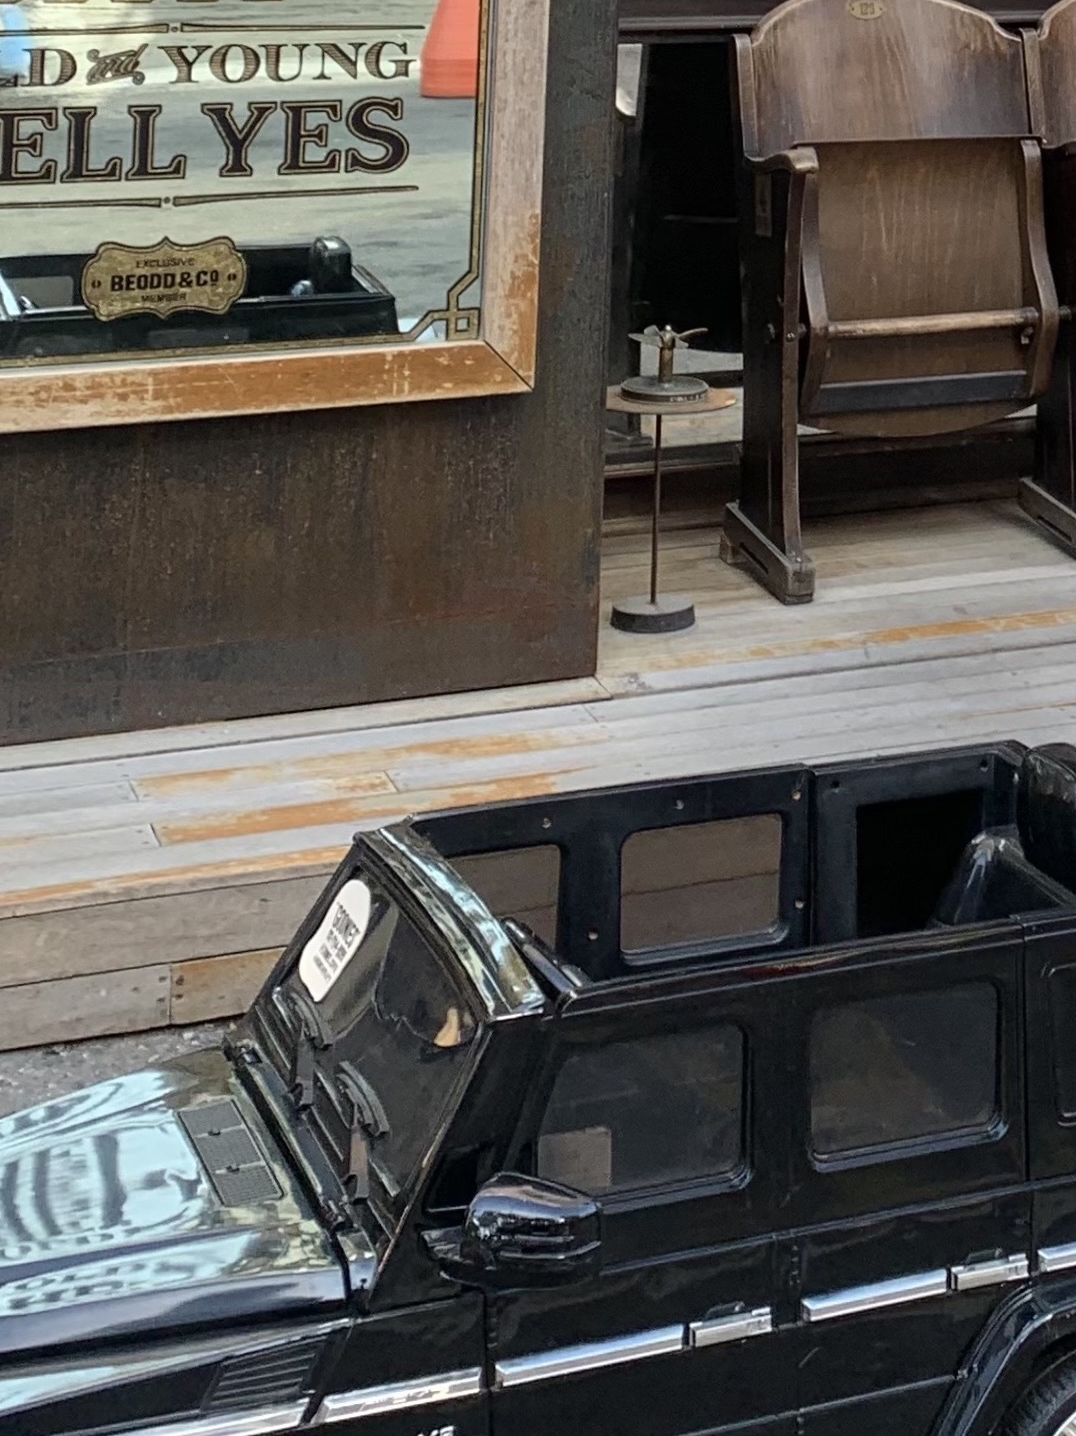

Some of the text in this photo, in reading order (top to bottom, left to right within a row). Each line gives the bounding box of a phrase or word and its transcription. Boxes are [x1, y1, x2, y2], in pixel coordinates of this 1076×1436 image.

[157, 41, 417, 83] YOUNG
[201, 97, 410, 177] YES
[136, 257, 197, 268] EXCLUSIVE
[141, 292, 187, 302] MEMBER
